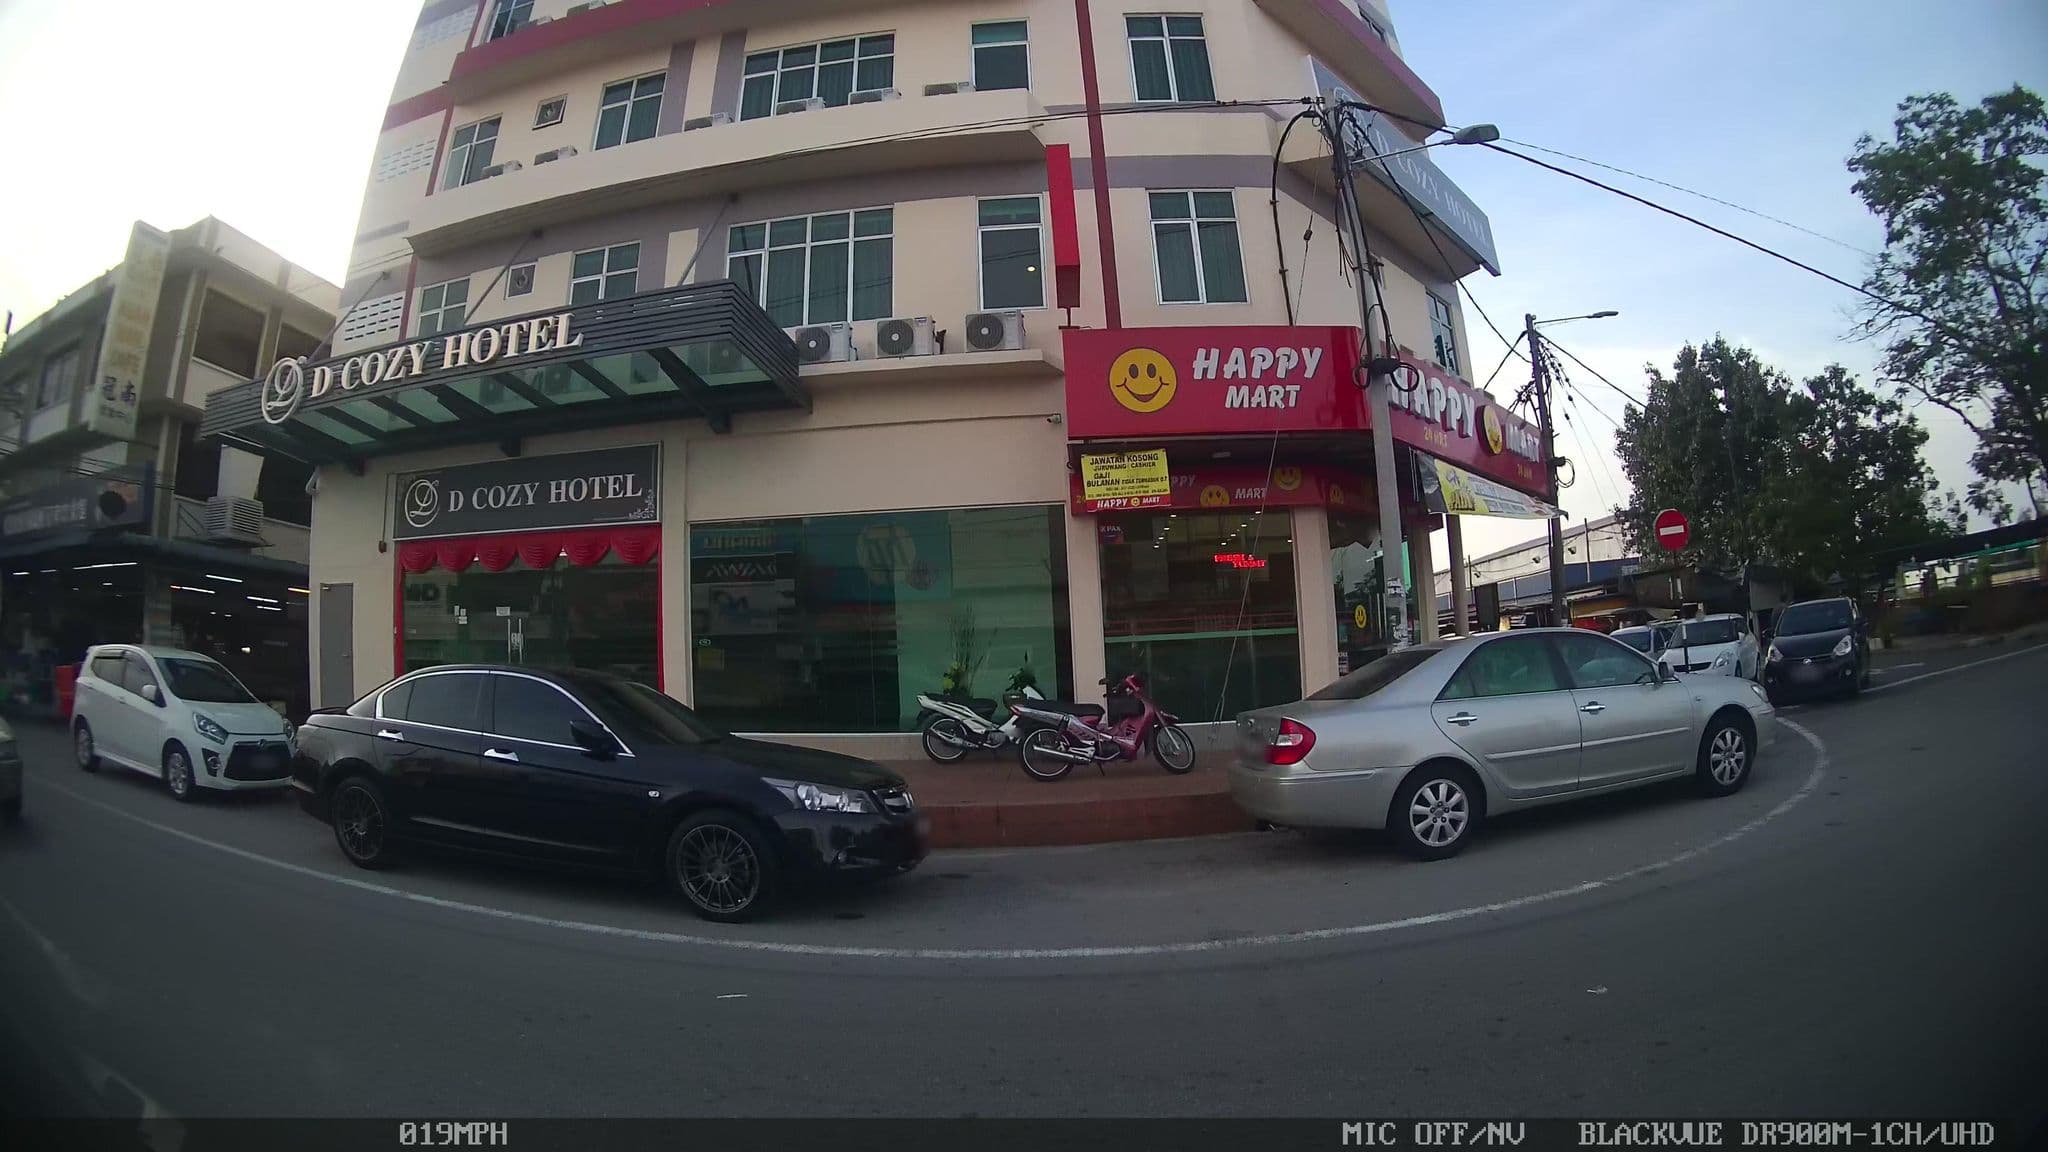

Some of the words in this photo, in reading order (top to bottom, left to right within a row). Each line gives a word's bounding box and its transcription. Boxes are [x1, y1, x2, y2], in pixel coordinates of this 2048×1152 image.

[310, 366, 334, 398] D
[341, 340, 434, 390] COZY
[439, 313, 584, 369] HOTEL
[1192, 346, 1322, 380] HAPPY
[1225, 385, 1301, 409] MART
[1386, 367, 1475, 438] HAPPY
[1090, 456, 1125, 466] JAWATAN
[1127, 453, 1159, 463] KOSONG
[1094, 464, 1126, 472] JURUWANG
[1131, 461, 1156, 469] CASHIER
[1087, 478, 1120, 487] BULANAN
[1094, 471, 1111, 480] GAJI
[1170, 475, 1196, 488] PPY
[1235, 488, 1267, 500] MART
[448, 490, 464, 512] D
[472, 482, 540, 510] COZY
[548, 473, 643, 503] HOTEL
[1097, 498, 1128, 509] HAPPY
[1142, 496, 1160, 505] MART
